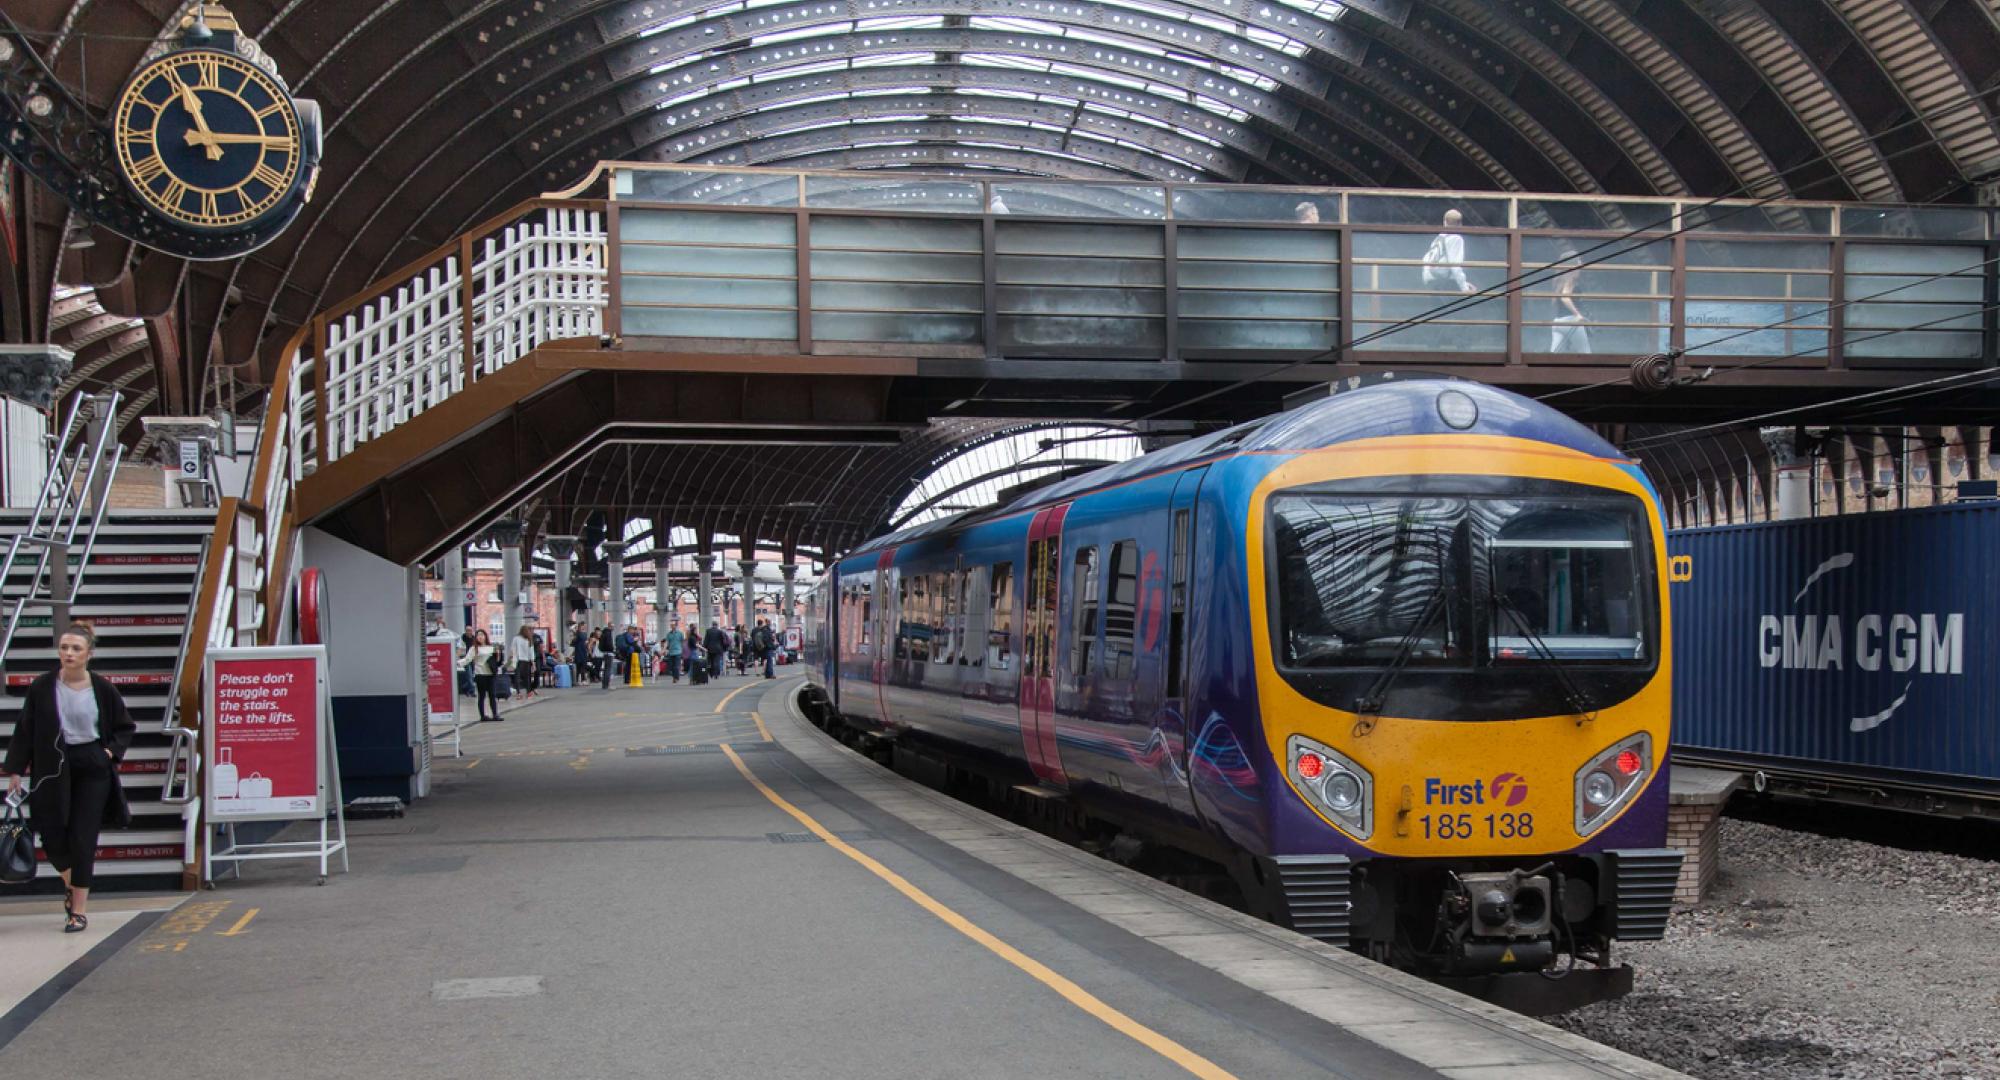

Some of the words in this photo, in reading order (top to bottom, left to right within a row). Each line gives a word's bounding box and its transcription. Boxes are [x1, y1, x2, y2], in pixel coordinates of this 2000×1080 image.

[198, 61, 219, 88] XII
[96, 617, 108, 625] NO
[110, 617, 135, 625] ENTRY
[1759, 614, 1843, 671] CMA
[1856, 613, 1964, 675] CGM
[112, 676, 139, 684] ENTRY
[219, 673, 260, 685] Please
[262, 672, 294, 684] don't
[219, 686, 270, 700] struggle
[272, 687, 288, 697] on
[219, 700, 240, 711] the
[242, 699, 280, 711] stairs.
[219, 713, 243, 725] Use
[246, 712, 267, 724] the
[268, 711, 296, 725] lifts.
[1425, 778, 1485, 805] First
[1419, 814, 1473, 839] 185
[1484, 812, 1534, 838] 138
[127, 848, 142, 857] NO
[143, 847, 176, 857] ENTRY
